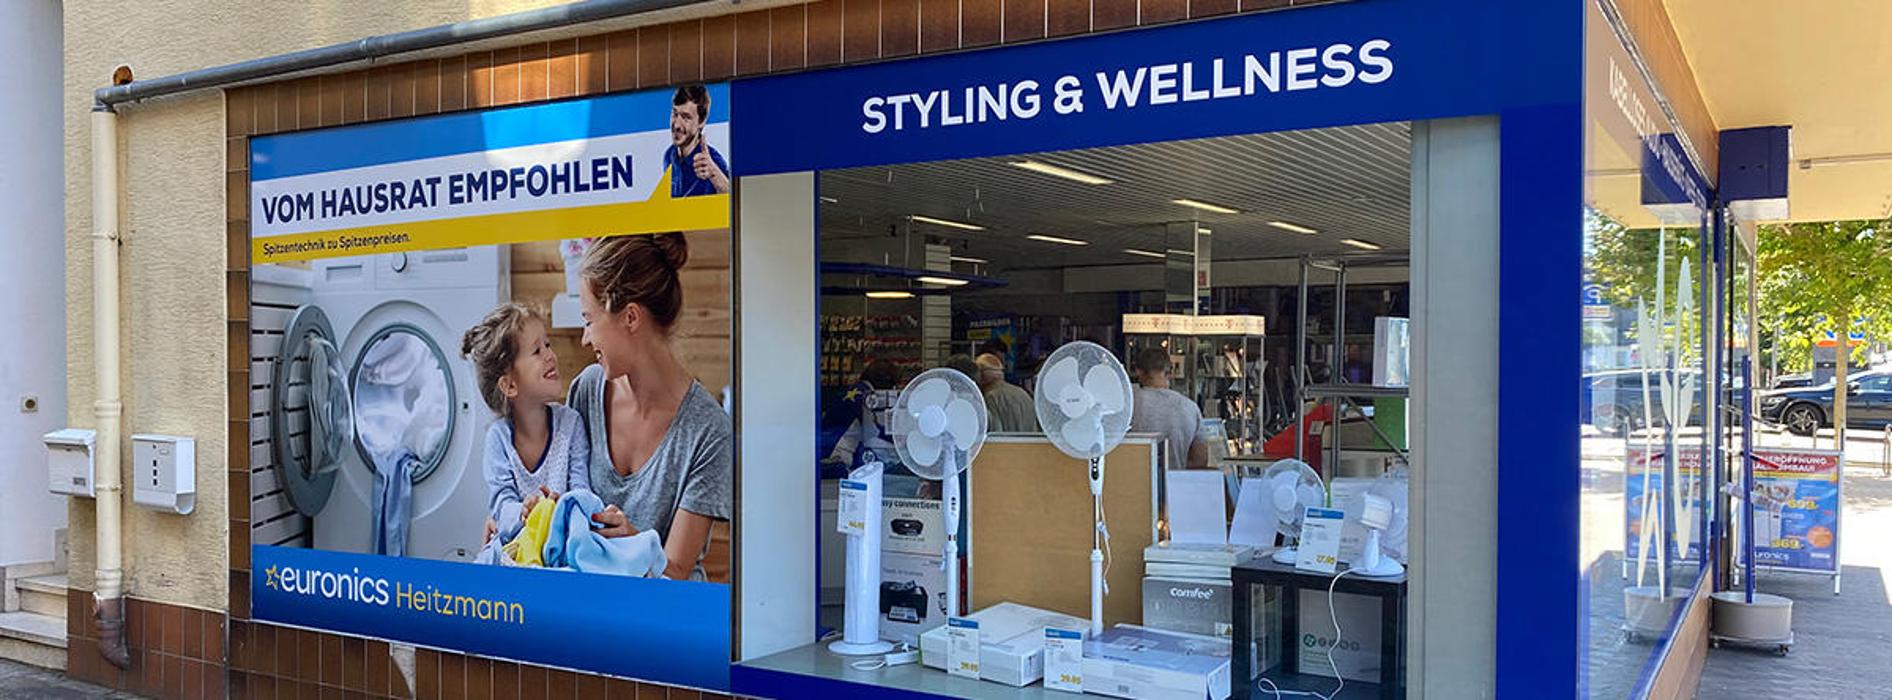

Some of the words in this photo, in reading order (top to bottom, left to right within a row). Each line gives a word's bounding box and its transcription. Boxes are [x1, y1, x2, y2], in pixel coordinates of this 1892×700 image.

[862, 80, 1040, 134] STYLING
[1053, 75, 1083, 115] &
[1096, 39, 1394, 110] WELLNESS
[261, 192, 315, 225] VOM
[321, 177, 442, 218] HAUSRAT
[449, 155, 634, 205] EMPFOHLEN
[263, 239, 325, 257] Spitzentechnik
[328, 241, 338, 249] zu
[339, 231, 410, 248] Spitzenpreisen.
[280, 567, 389, 606] euronics
[395, 581, 524, 625] Heitzmann
